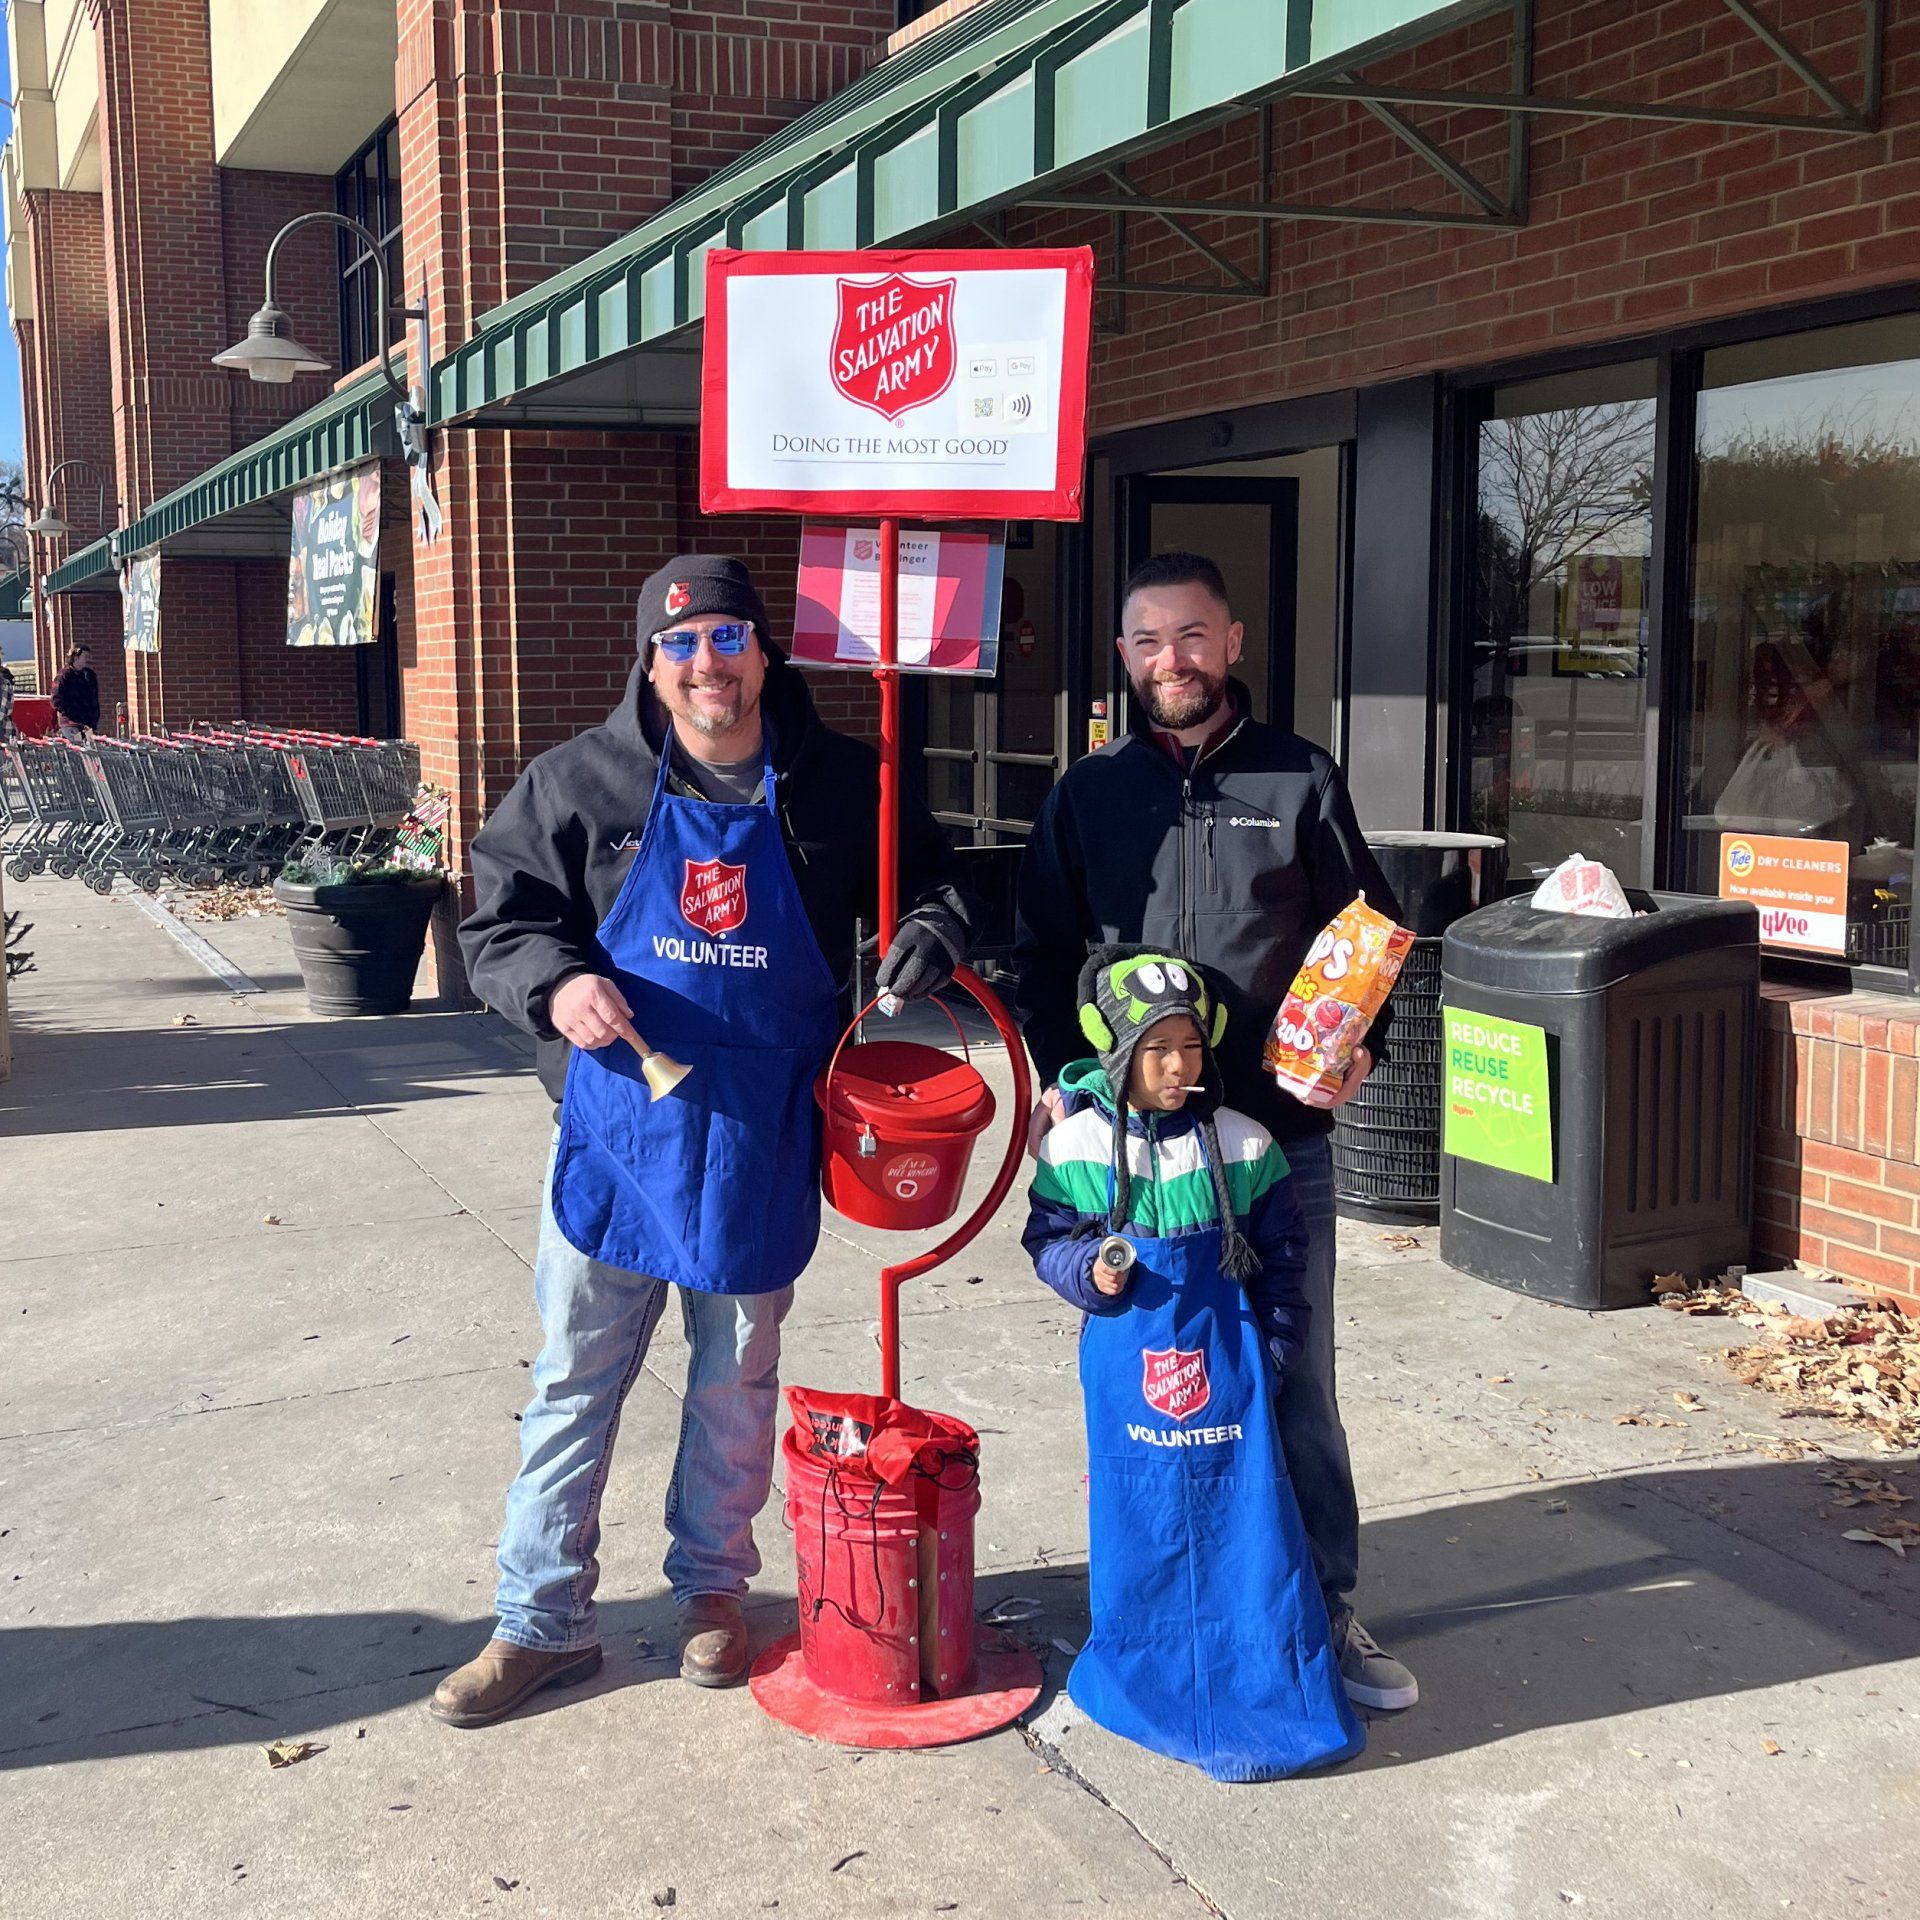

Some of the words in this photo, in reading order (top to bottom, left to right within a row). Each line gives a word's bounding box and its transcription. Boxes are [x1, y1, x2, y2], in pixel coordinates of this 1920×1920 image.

[855, 287, 904, 333] THE
[838, 294, 945, 383] SALVATION
[874, 335, 940, 401] ARMY
[980, 364, 993, 373] Pay
[773, 434, 840, 453] DOING
[845, 438, 881, 453] THE
[886, 439, 940, 454] MOST
[945, 439, 1007, 455] GOOD
[875, 540, 928, 550] Vnteer
[1582, 580, 1617, 596] LOW
[1580, 600, 1617, 611] PRICE
[1240, 817, 1280, 827] Columbia
[1731, 850, 1751, 868] Tide
[1757, 856, 1780, 868] DRY
[1782, 858, 1841, 874] CLEANERS
[695, 866, 721, 889] THE
[684, 872, 742, 915] SALVATION
[1729, 884, 1748, 895] Now
[1750, 886, 1786, 899] available
[1788, 890, 1813, 903] inside
[1815, 895, 1836, 905] your
[704, 894, 739, 926] ARMY
[1762, 911, 1808, 937] yVee
[653, 935, 768, 969] VOLUNTEER
[1451, 1021, 1522, 1056] REDUCE
[1452, 1049, 1509, 1080] REUSE
[1452, 1076, 1533, 1115] RECYCLE
[1147, 1356, 1201, 1400] SALVATION
[1153, 1356, 1178, 1377] THE
[1168, 1377, 1200, 1412] ARMY
[1127, 1423, 1243, 1447] VOLUNTEER
